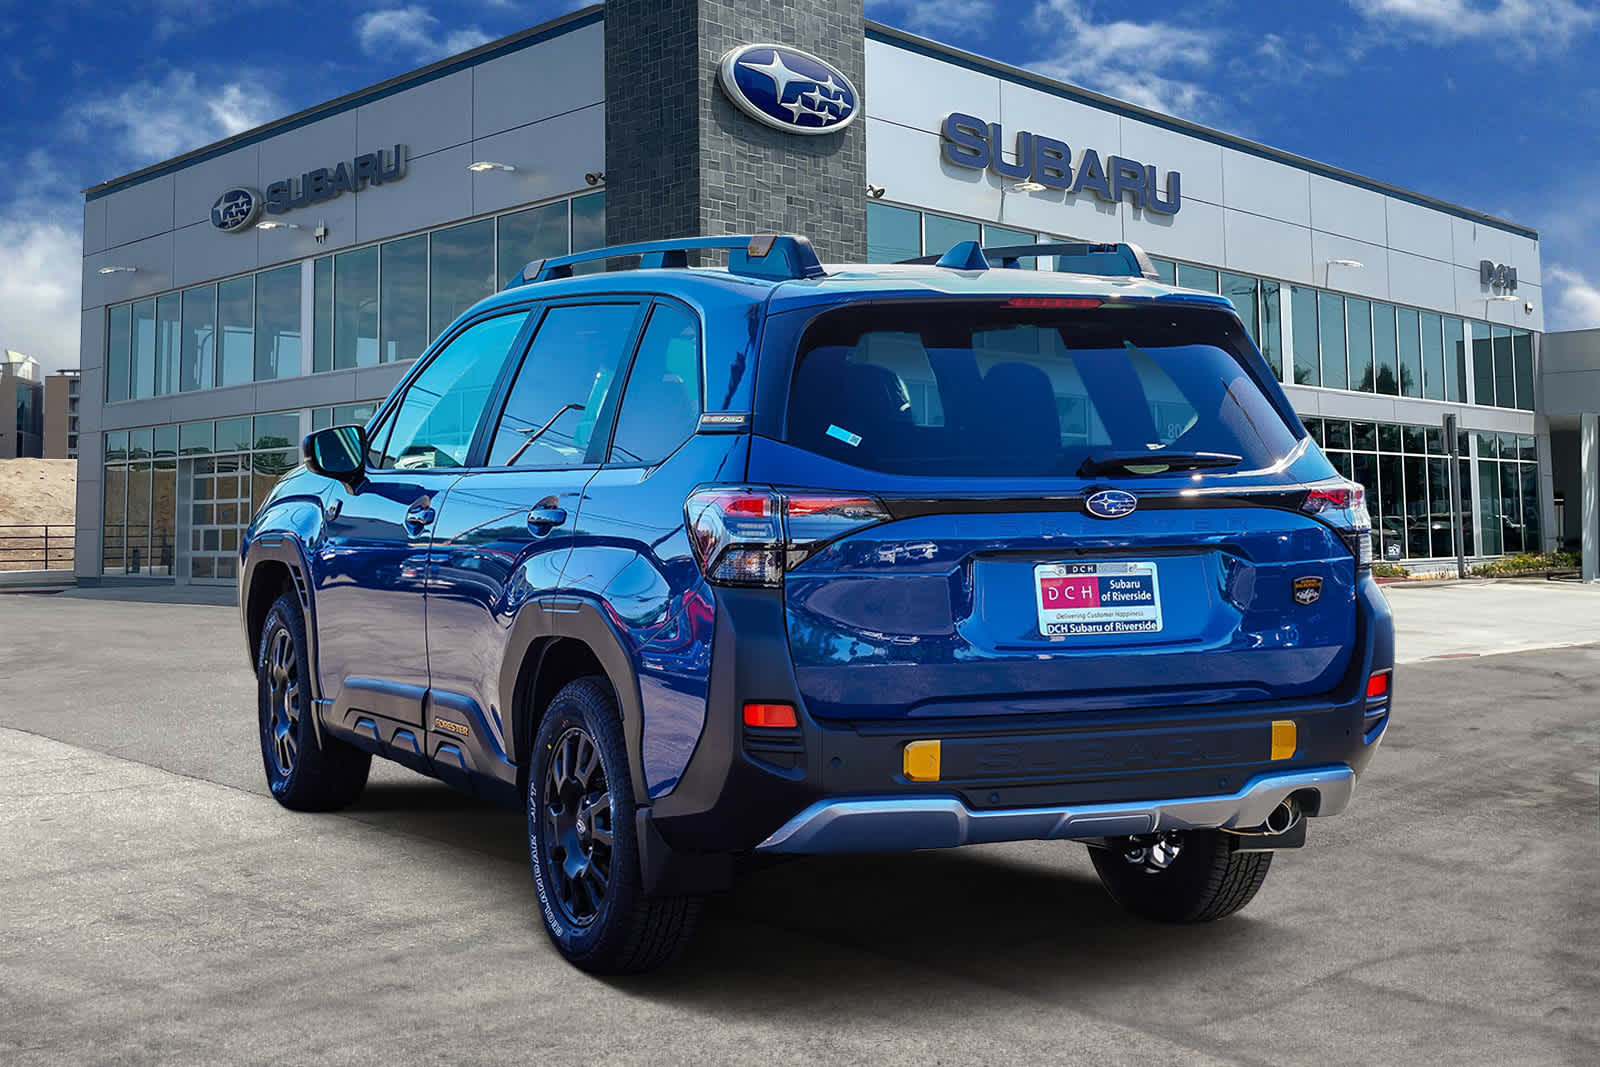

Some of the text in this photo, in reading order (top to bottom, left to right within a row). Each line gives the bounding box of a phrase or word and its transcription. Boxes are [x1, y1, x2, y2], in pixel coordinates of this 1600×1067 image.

[942, 112, 1181, 215] SUBARU
[266, 144, 406, 214] SUBARU
[1109, 579, 1140, 589] Subaru
[1048, 585, 1093, 600] DCH
[1101, 589, 1152, 602] of Riverside
[1056, 609, 1144, 621] Delivering Customer Happiness
[1047, 620, 1157, 634] DCH Subaru of Riverside
[435, 718, 469, 736] FORESTER
